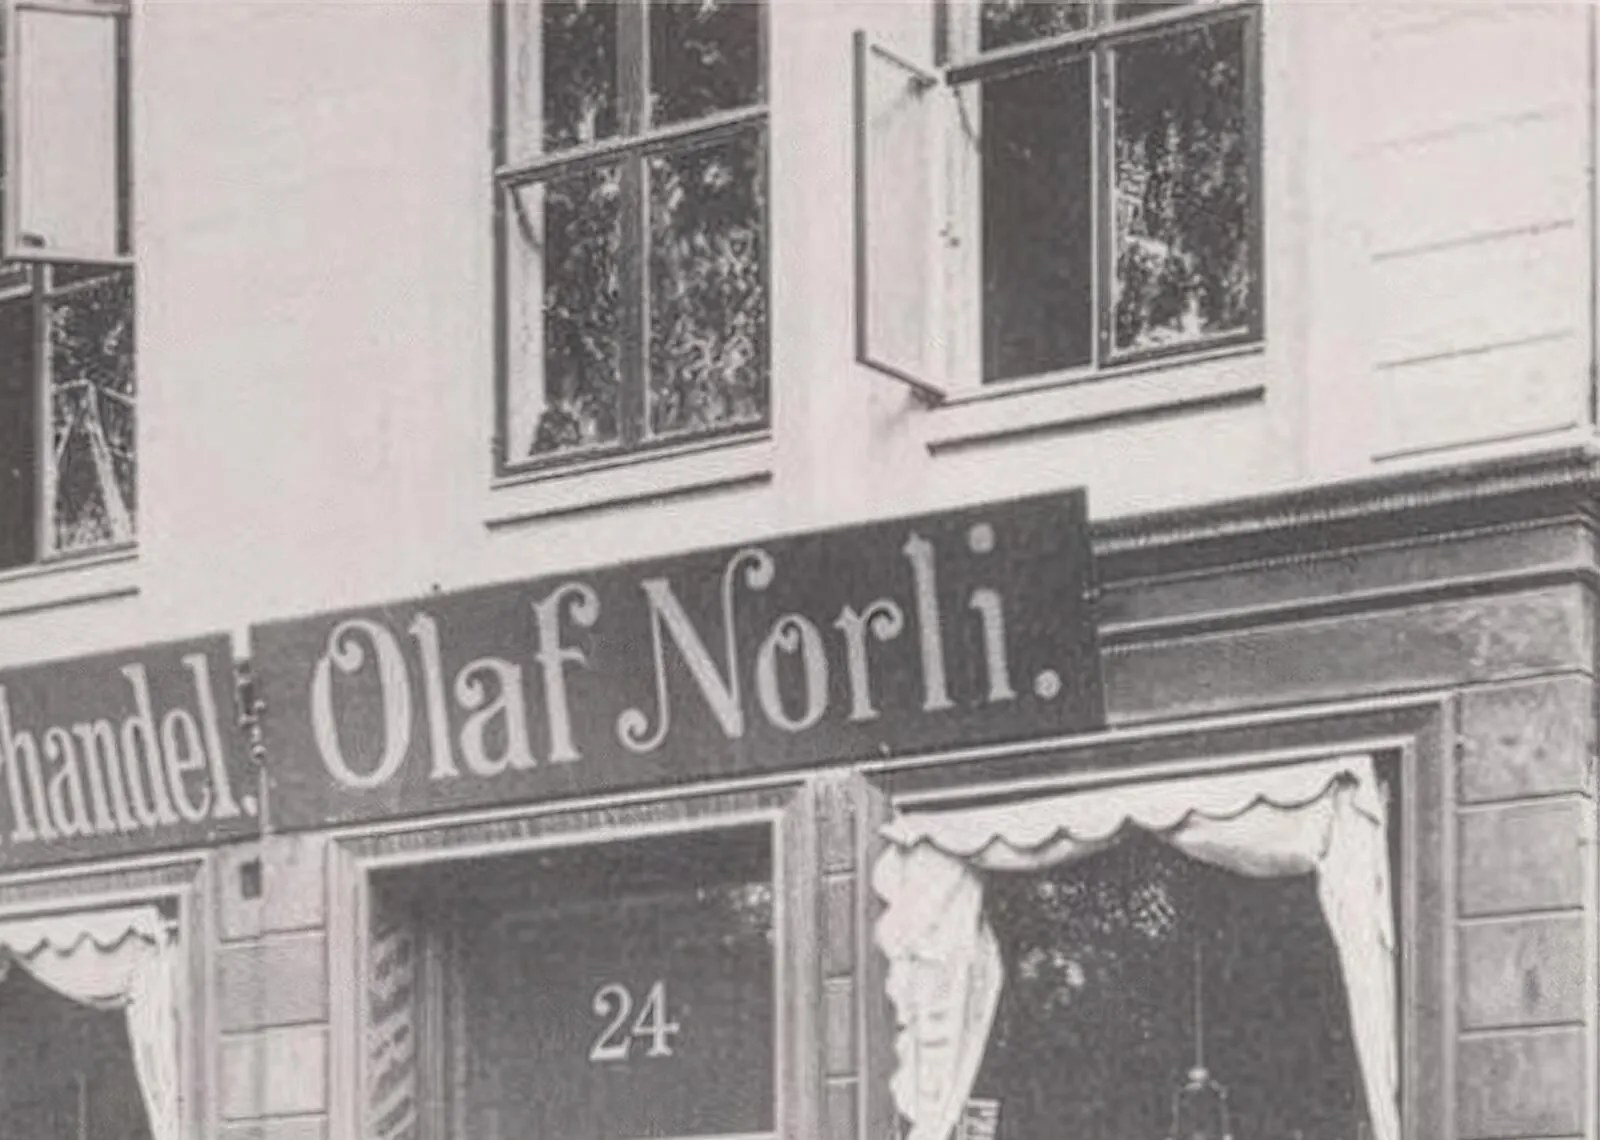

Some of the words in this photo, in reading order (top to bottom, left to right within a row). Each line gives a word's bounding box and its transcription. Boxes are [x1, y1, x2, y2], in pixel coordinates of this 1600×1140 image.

[310, 581, 601, 790] Olaf
[617, 522, 1062, 753] Norli.
[589, 981, 681, 1062] 24
